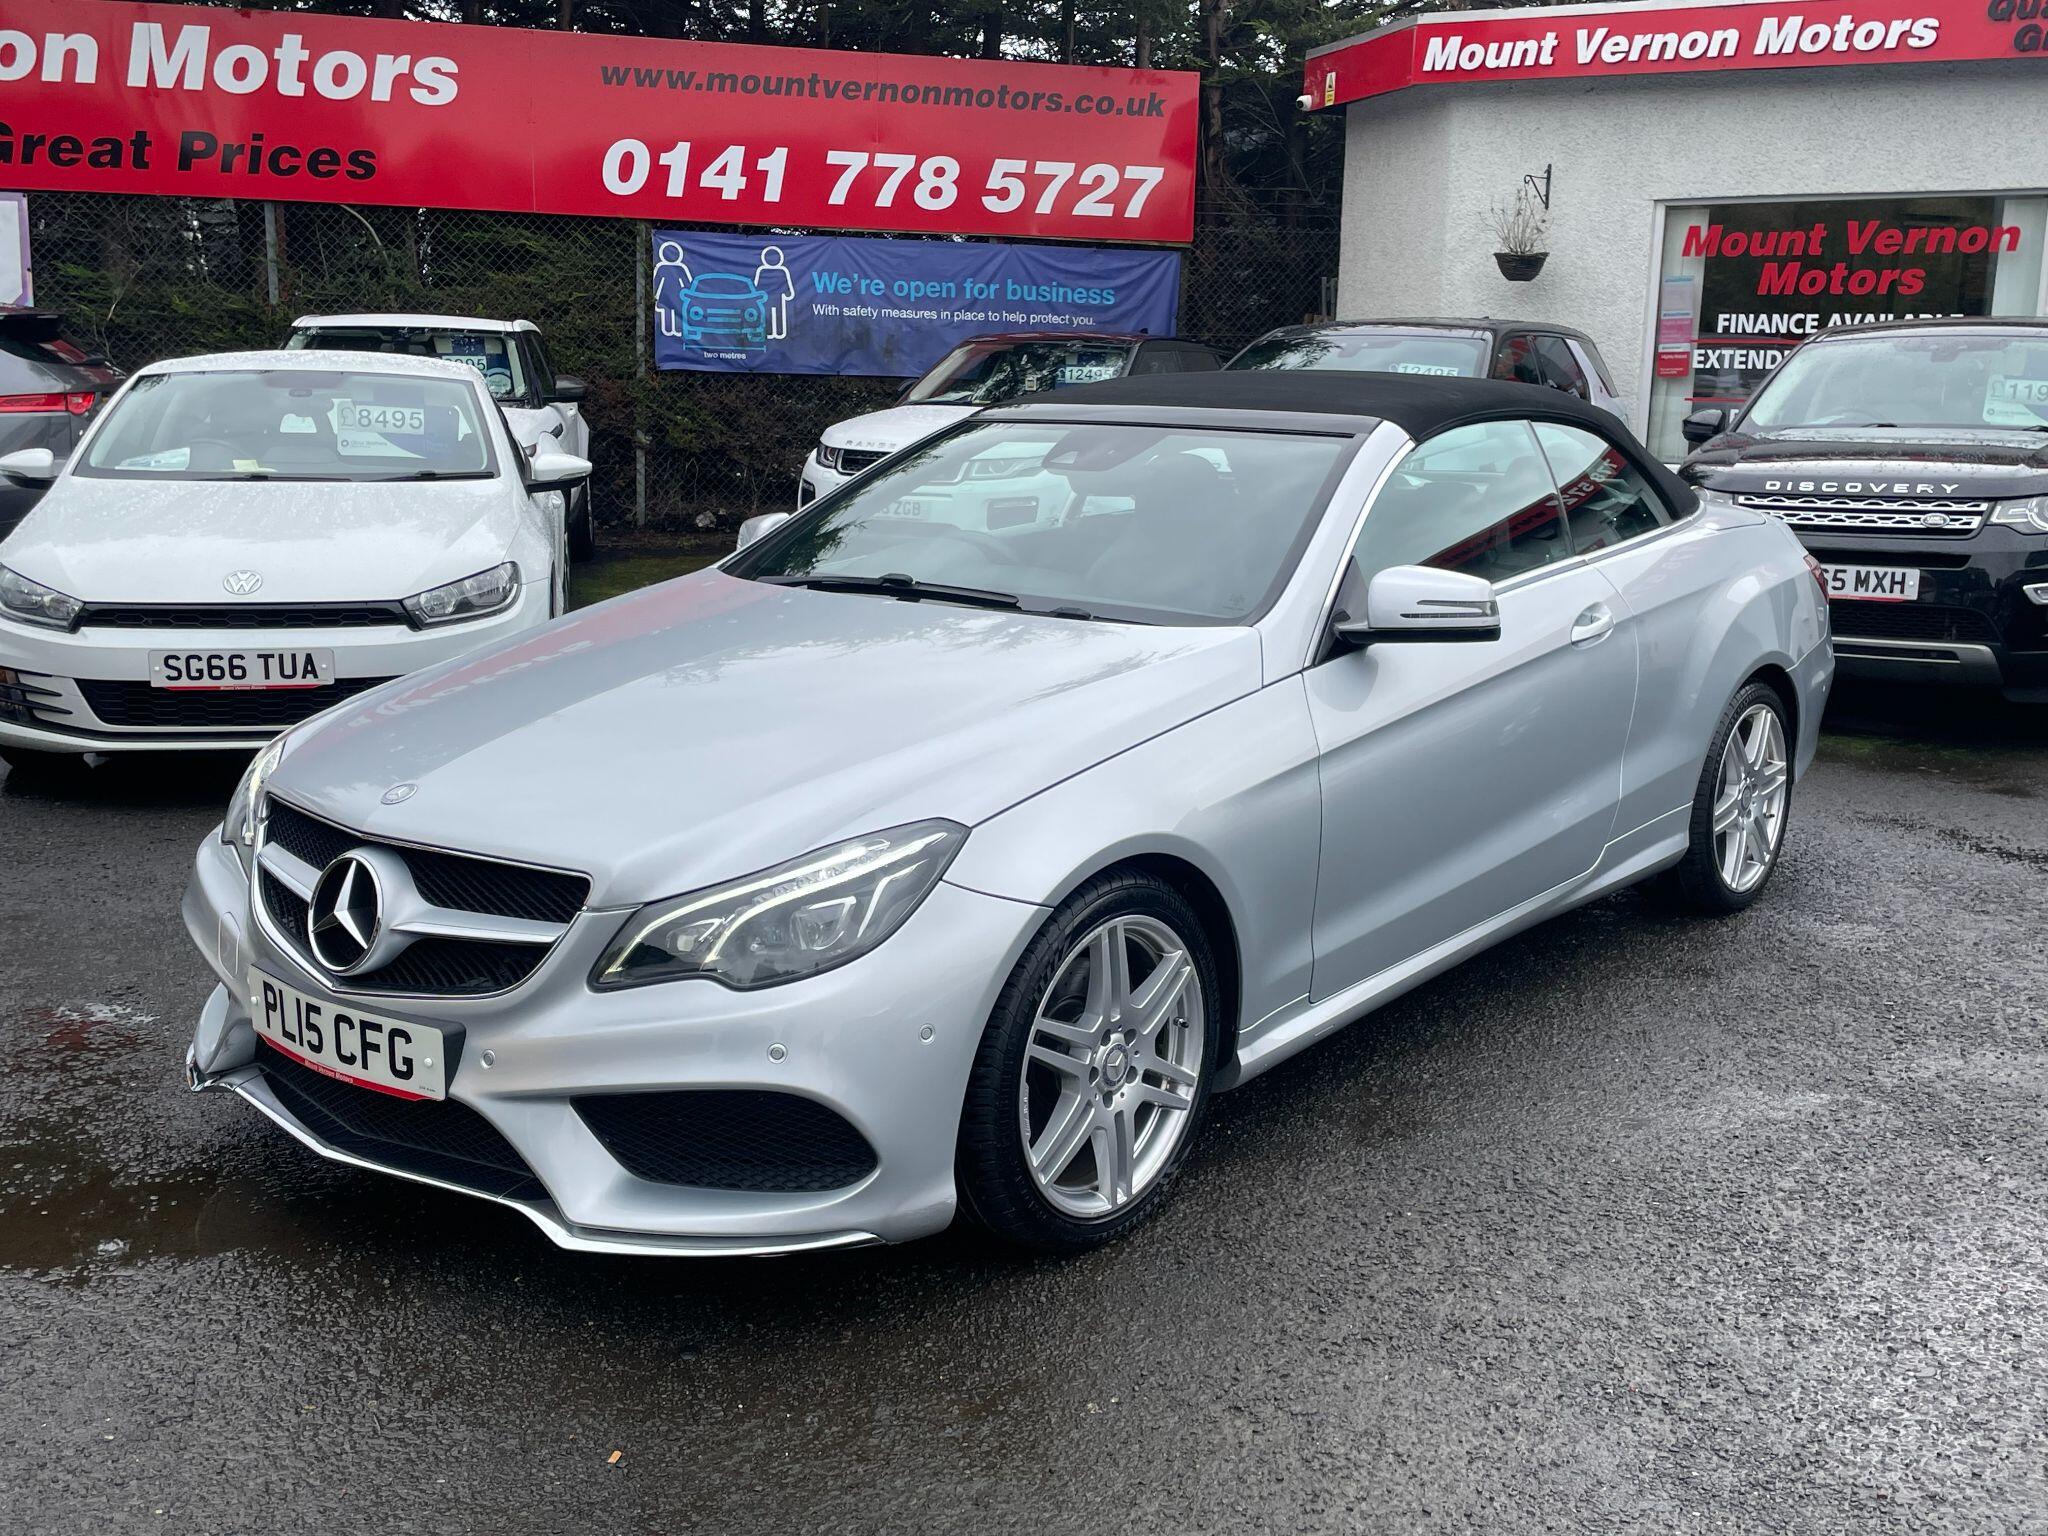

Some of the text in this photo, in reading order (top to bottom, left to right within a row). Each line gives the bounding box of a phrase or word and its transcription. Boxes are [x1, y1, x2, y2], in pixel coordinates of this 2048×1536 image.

[1423, 14, 1941, 72] Mount Vernon Motors
[127, 22, 459, 106] Motors
[601, 63, 1165, 119] www.mountvernonmotors.co.uk
[178, 131, 377, 180] Prices
[602, 138, 1165, 219] 0141 778 5727
[1682, 220, 2021, 258] Mount Vernon
[893, 278, 955, 302] open
[963, 278, 1000, 299] for
[1006, 279, 1115, 305] business
[1757, 261, 1926, 296] Motors
[812, 303, 1096, 327] With safety measures in place to help protect you.
[1717, 313, 1819, 334] FINANCE
[720, 352, 746, 360] metres
[1692, 348, 1791, 369] EXTEND
[1765, 480, 1959, 494] DISCOVERY
[1854, 570, 1906, 594] MXH
[163, 653, 319, 681] SG66 TUA
[263, 980, 414, 1081] PL15 CFG
